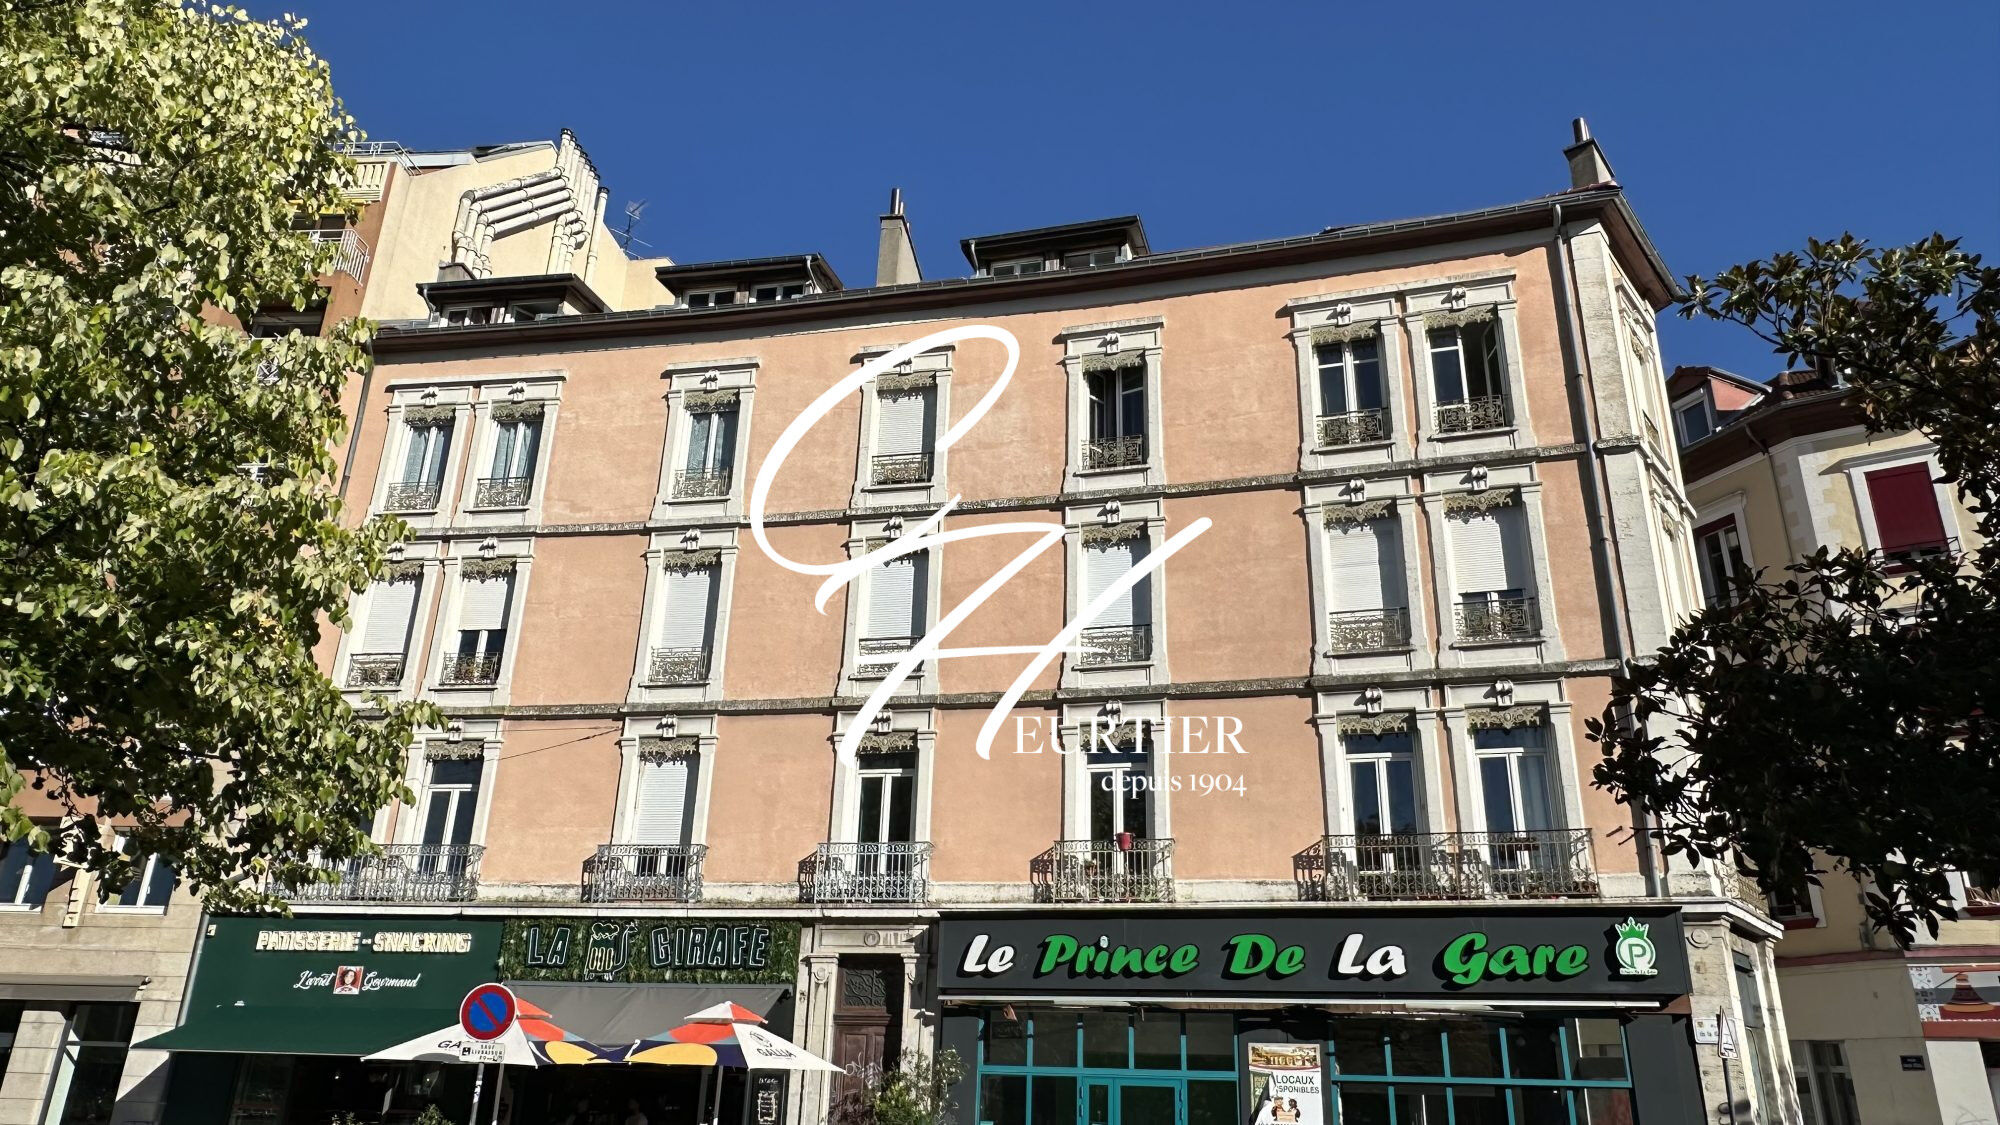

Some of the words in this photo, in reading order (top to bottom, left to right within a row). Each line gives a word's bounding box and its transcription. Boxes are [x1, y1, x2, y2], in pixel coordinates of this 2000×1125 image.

[373, 931, 471, 953] SNACKING
[527, 927, 570, 964] LA
[651, 927, 769, 966] GIRAFE
[963, 934, 1014, 973] Le
[1040, 934, 1200, 974] Prince
[1229, 934, 1305, 975] De
[1338, 933, 1406, 975] La
[1443, 932, 1589, 985] Gare
[362, 971, 421, 990] Gourmand
[1275, 1075, 1315, 1085] LOCAUX
[1276, 1085, 1320, 1094] SPONIBLES
